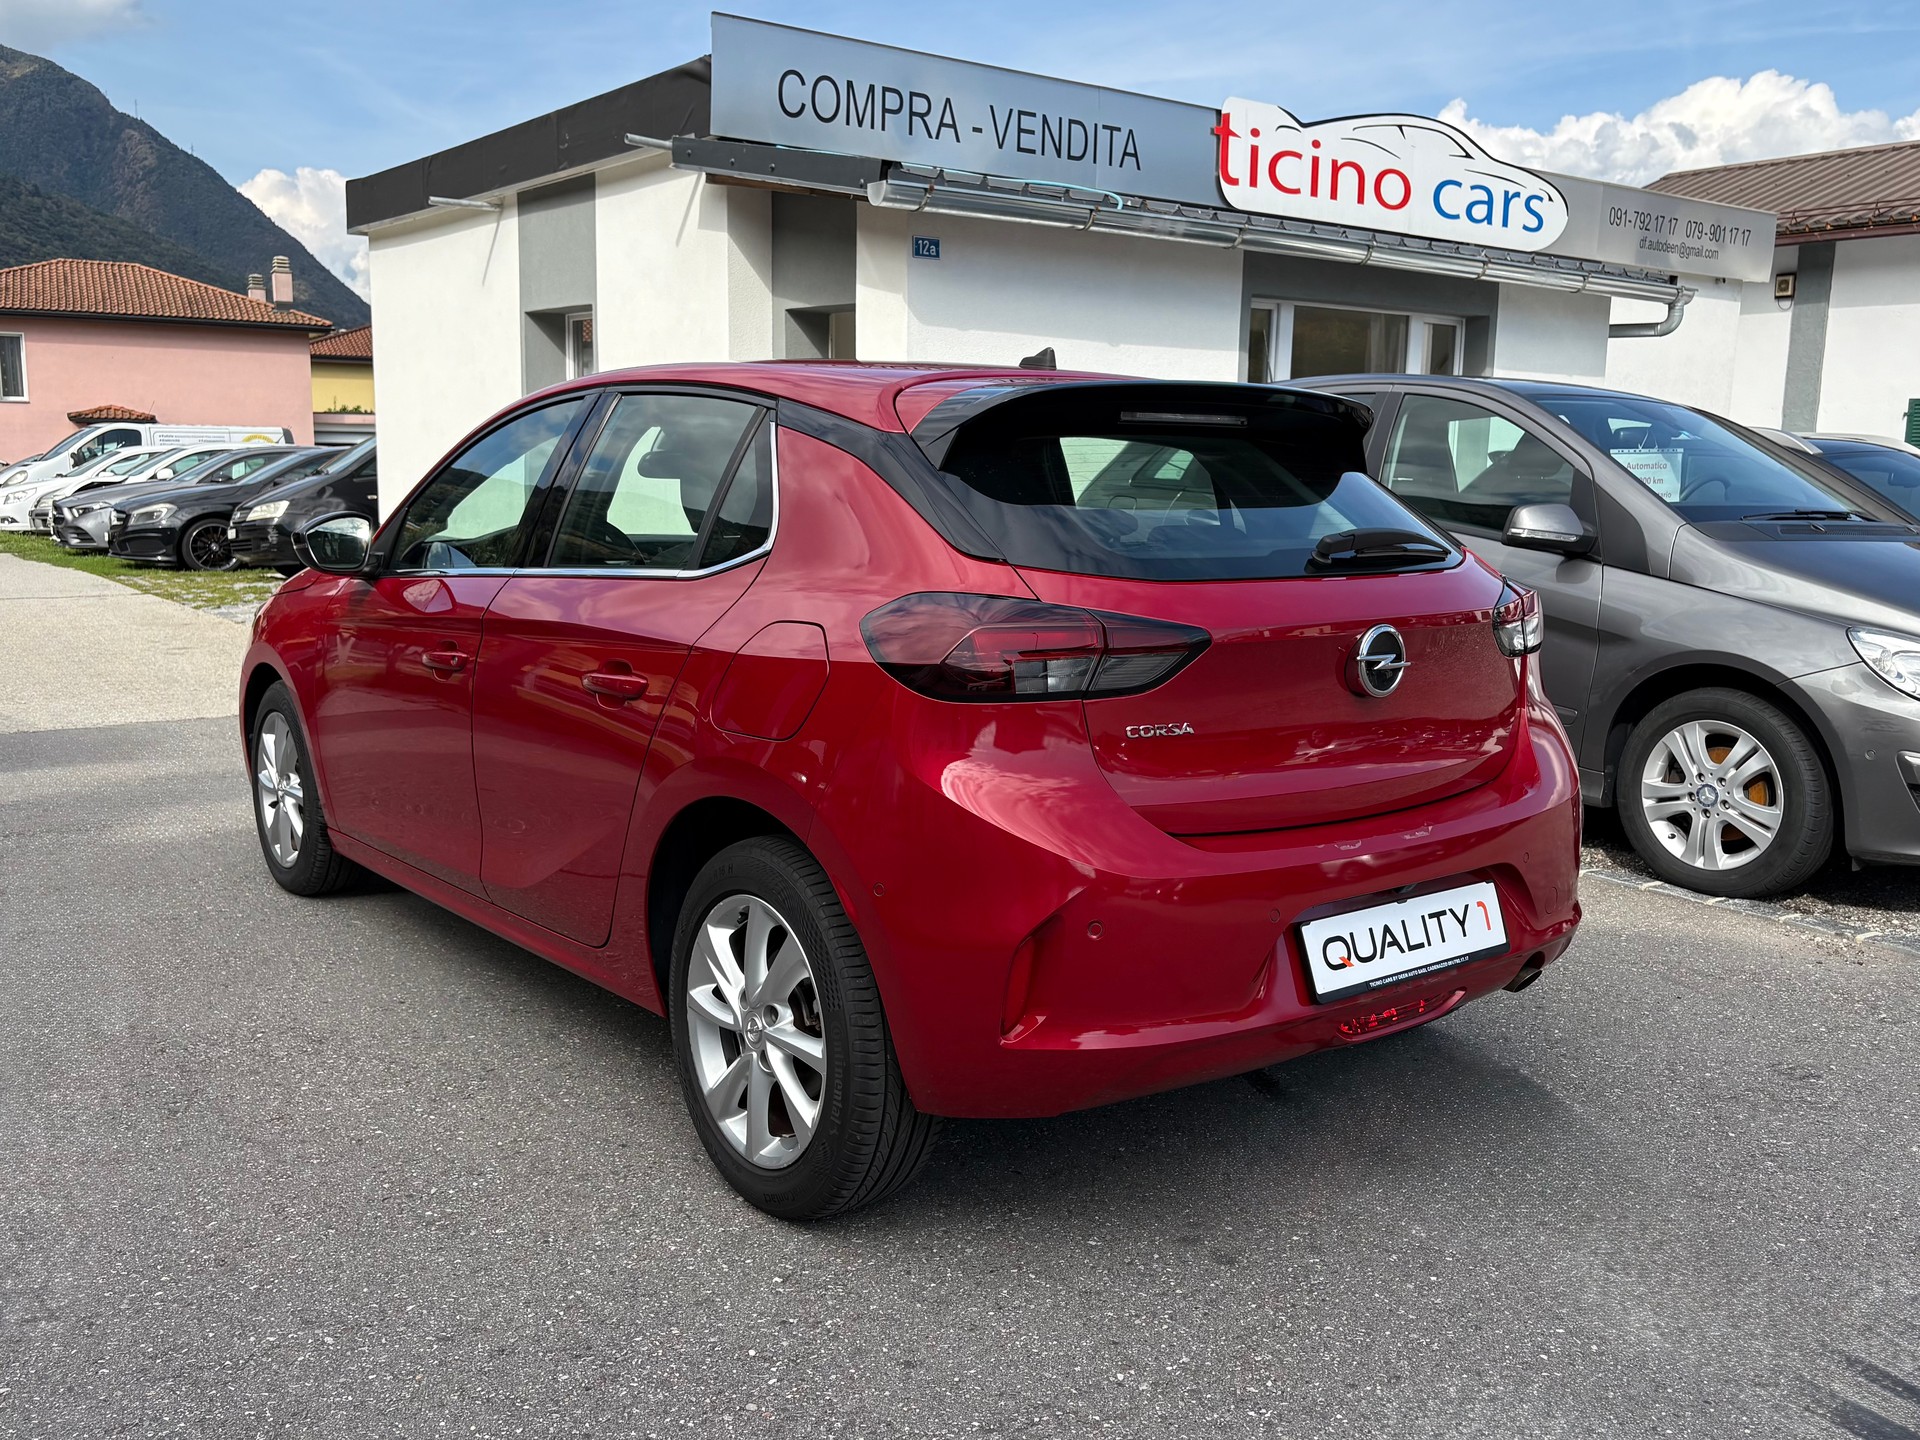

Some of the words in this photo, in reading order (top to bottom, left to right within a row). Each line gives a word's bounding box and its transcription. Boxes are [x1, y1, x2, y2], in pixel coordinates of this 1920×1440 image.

[777, 69, 961, 143] COMPRA
[989, 104, 1142, 171] VENDITA
[1214, 112, 1412, 211] ticino
[1433, 178, 1545, 233] cars
[1608, 206, 1651, 232] 091-792
[1654, 214, 1665, 234] 17
[1668, 217, 1679, 236] 17
[1729, 227, 1740, 245] 17
[1741, 228, 1752, 247] 17
[918, 240, 936, 255] 12a
[1639, 236, 1719, 260] df.autodeen@gmail.com
[1652, 476, 1664, 484] km
[1125, 722, 1195, 739] CORSA
[1322, 904, 1470, 971] QUALITY
[1476, 900, 1492, 931] 1
